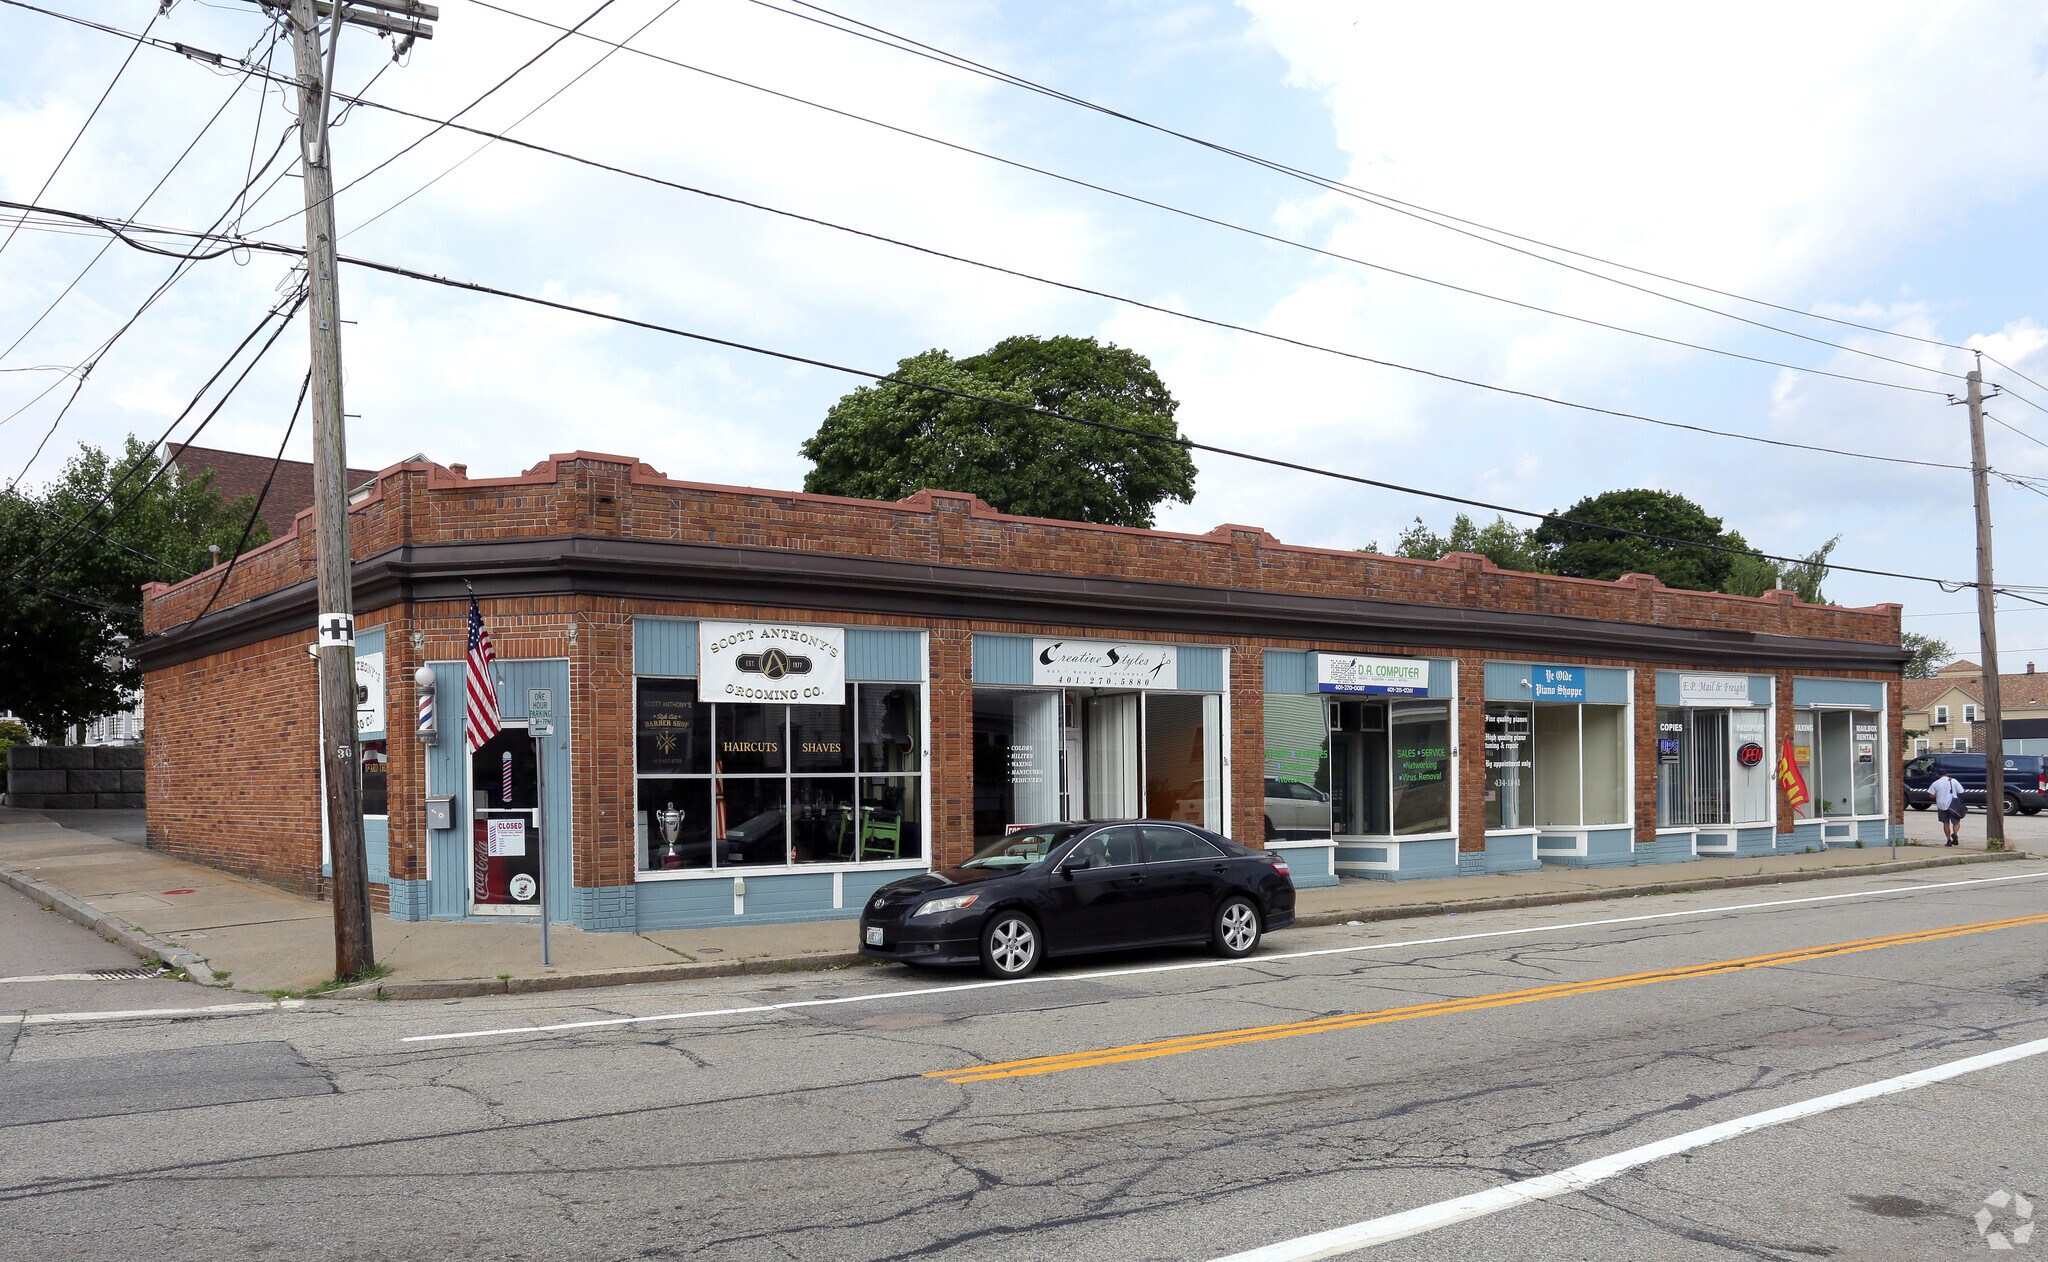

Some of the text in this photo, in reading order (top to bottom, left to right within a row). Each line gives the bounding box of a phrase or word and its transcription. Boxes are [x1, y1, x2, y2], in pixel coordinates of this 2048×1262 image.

[711, 628, 839, 658] SCOTT ANTHONY'S
[1039, 642, 1150, 671] Creative Styles
[355, 660, 381, 683] THONY'S
[1358, 664, 1419, 678] D.A. COMPUTER
[1545, 669, 1573, 683] Ye Olde
[725, 683, 825, 700] GROOMING CO.
[1535, 684, 1583, 698] Piano Shoppe
[1683, 681, 1746, 696] E.P. Mail & Freight
[534, 692, 546, 701] ONE
[532, 701, 548, 710] HOUR
[529, 710, 552, 718] PARKING
[644, 719, 690, 728] BARBER SHOP
[1660, 723, 1683, 732] COPIES
[1736, 724, 1765, 732] PASSPORT
[1795, 724, 1814, 732] FAXING
[1856, 733, 1878, 741] RENTALS
[723, 741, 778, 753] HAIRCUTS
[802, 742, 842, 753] SHAVES
[1660, 739, 1679, 755] UPS
[1397, 748, 1446, 758] SALES SERVICE
[1741, 748, 1763, 762] OPEN
[1405, 760, 1438, 770] Networking
[1493, 760, 1520, 769] appointment
[1401, 772, 1442, 782] Virus Removal
[498, 822, 523, 830] CLOSED
